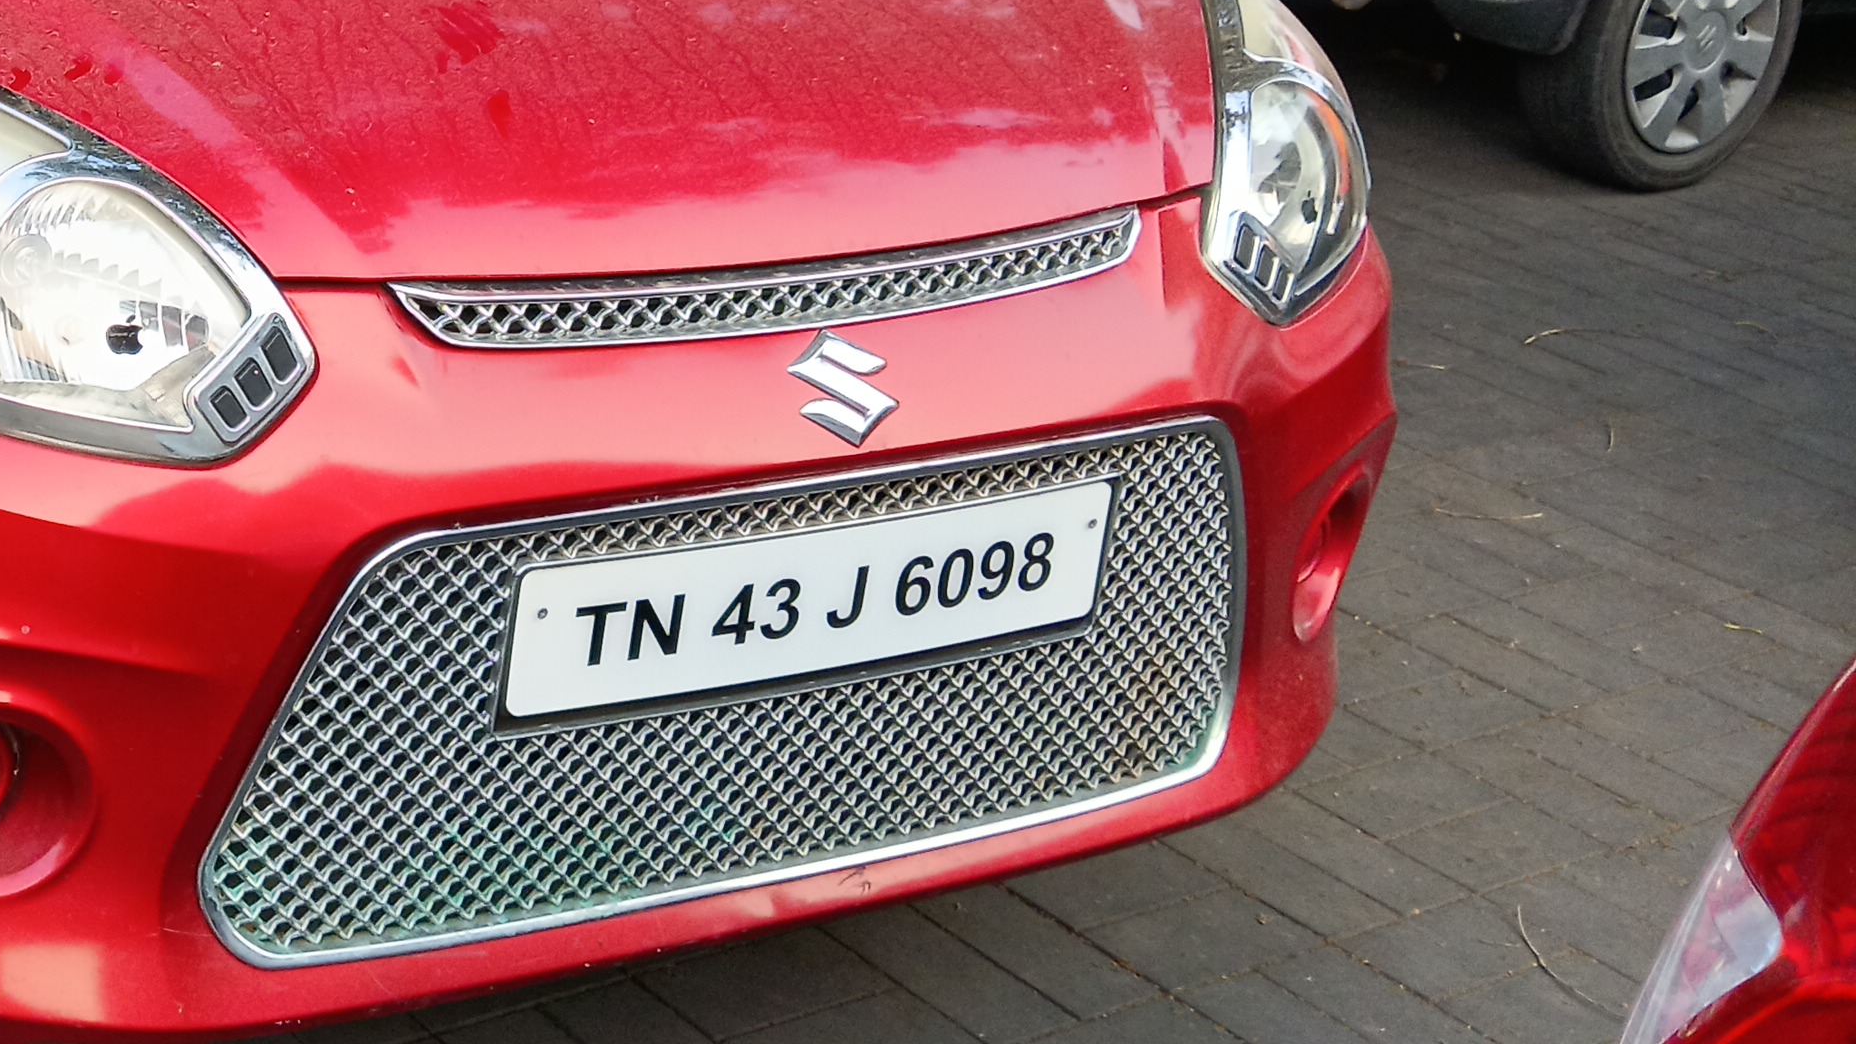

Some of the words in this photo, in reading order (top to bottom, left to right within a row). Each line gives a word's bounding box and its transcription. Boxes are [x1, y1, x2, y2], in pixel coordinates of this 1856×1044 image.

[575, 594, 685, 666] TN
[712, 578, 801, 645] 43
[826, 565, 870, 630] J
[895, 532, 1055, 616] 6098
